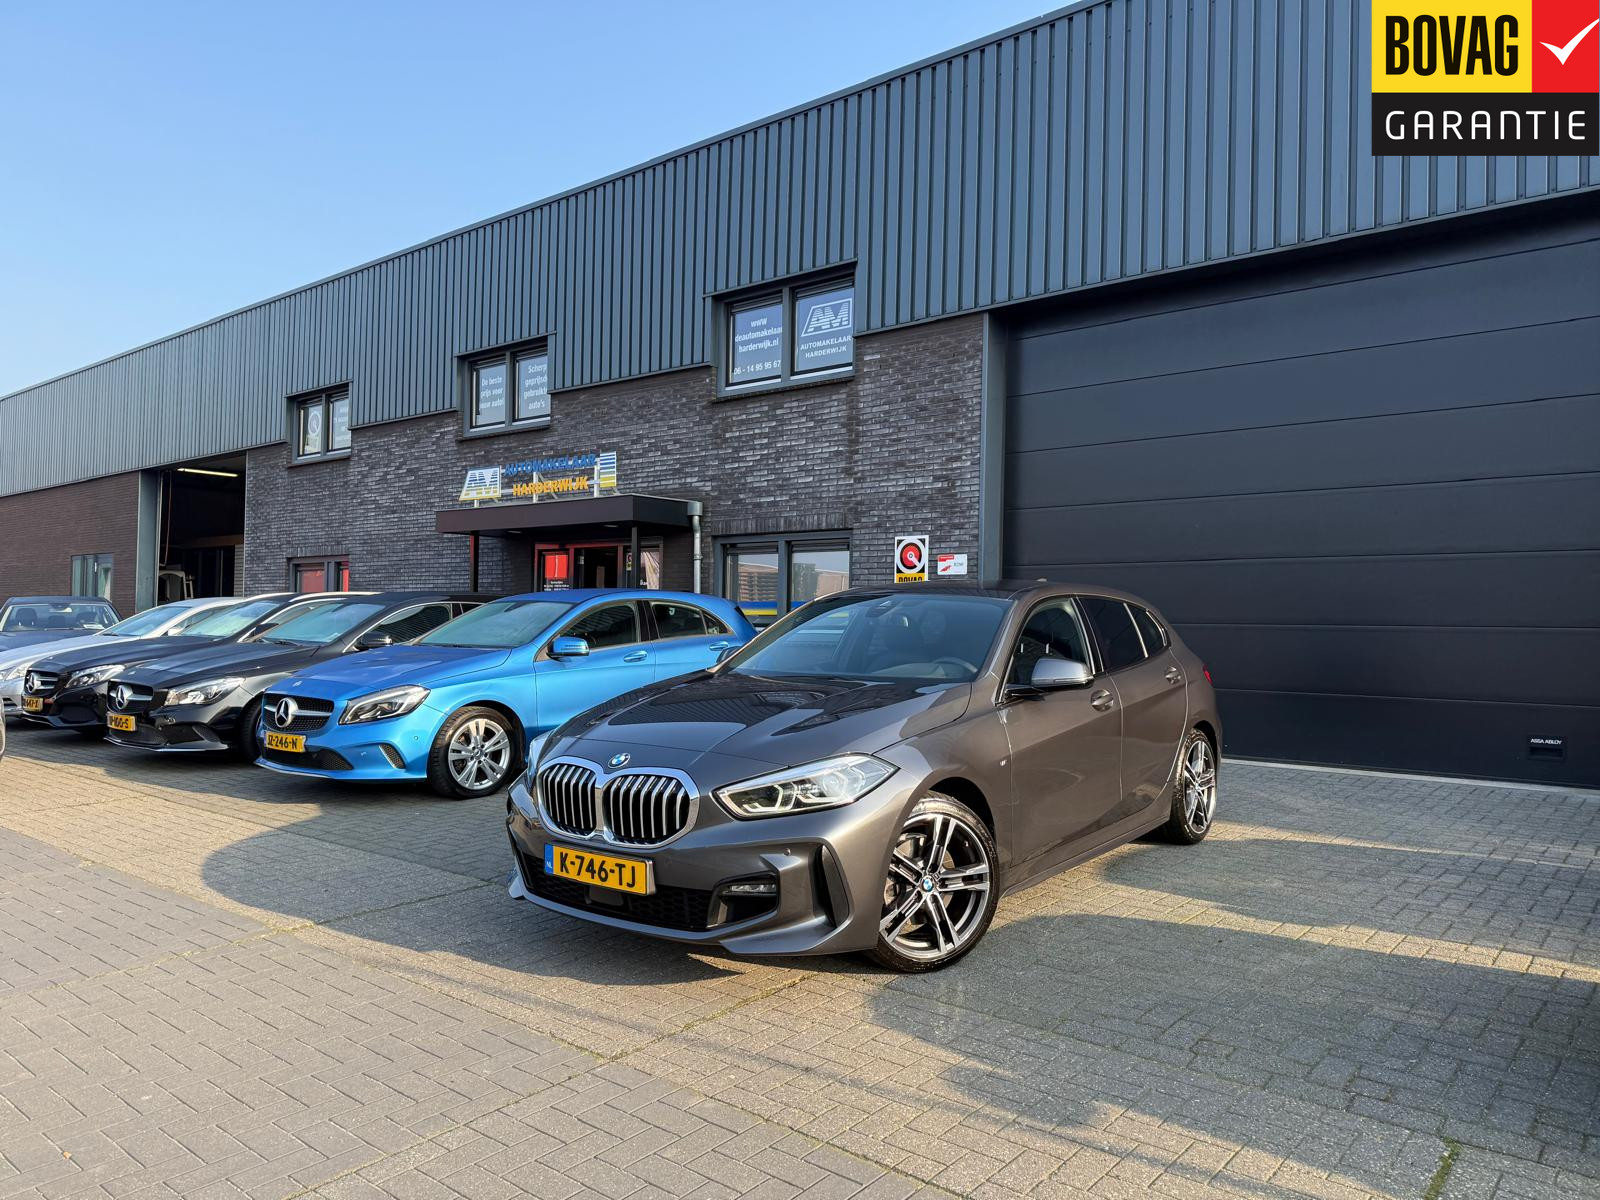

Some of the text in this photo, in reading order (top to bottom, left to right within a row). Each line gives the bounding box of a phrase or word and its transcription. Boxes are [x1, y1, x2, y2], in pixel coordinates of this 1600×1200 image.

[738, 337, 780, 353] harderwijk.nl
[800, 335, 852, 351] AUTOMAKELAAR
[805, 345, 847, 359] HARDERWIJK
[746, 364, 754, 373] 14
[755, 362, 763, 372] 95
[764, 361, 772, 371] 95
[504, 454, 596, 476] AUTOMAKELAAR
[513, 475, 589, 496] HARDERWIJK
[559, 851, 637, 888] K-746-TJ
